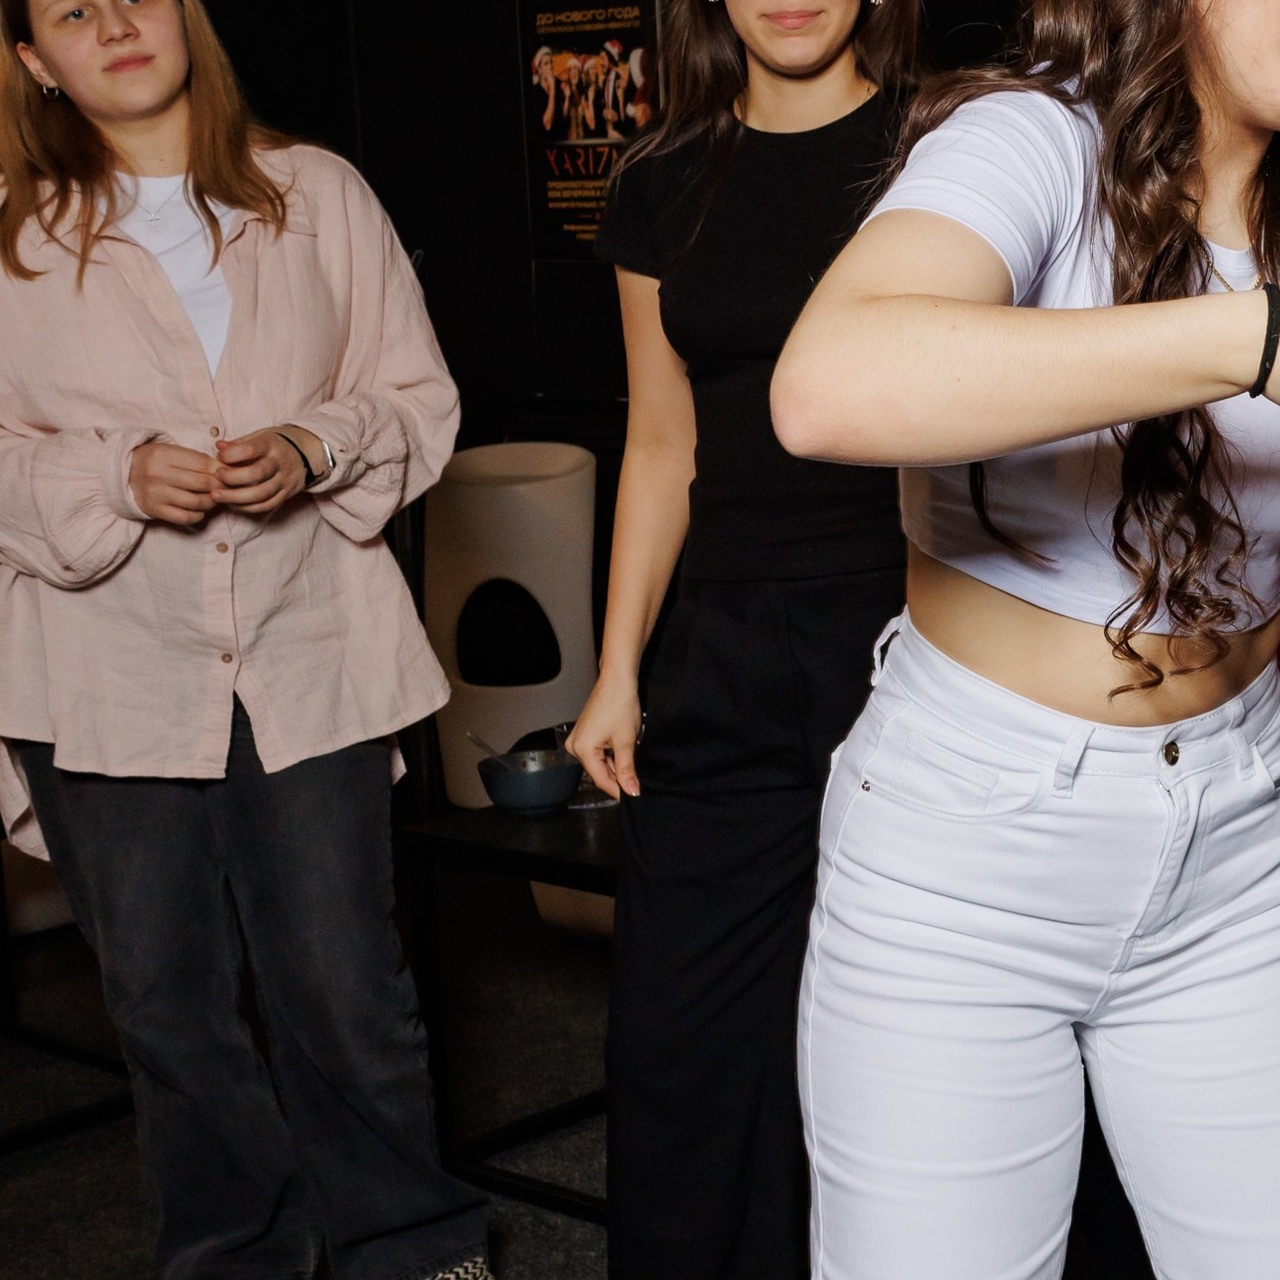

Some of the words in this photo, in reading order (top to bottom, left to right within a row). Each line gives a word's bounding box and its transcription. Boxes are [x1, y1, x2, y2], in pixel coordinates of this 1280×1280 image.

[536, 12, 554, 26] ДО
[555, 9, 606, 23] НОВОГО
[607, 6, 640, 20] ГОДА
